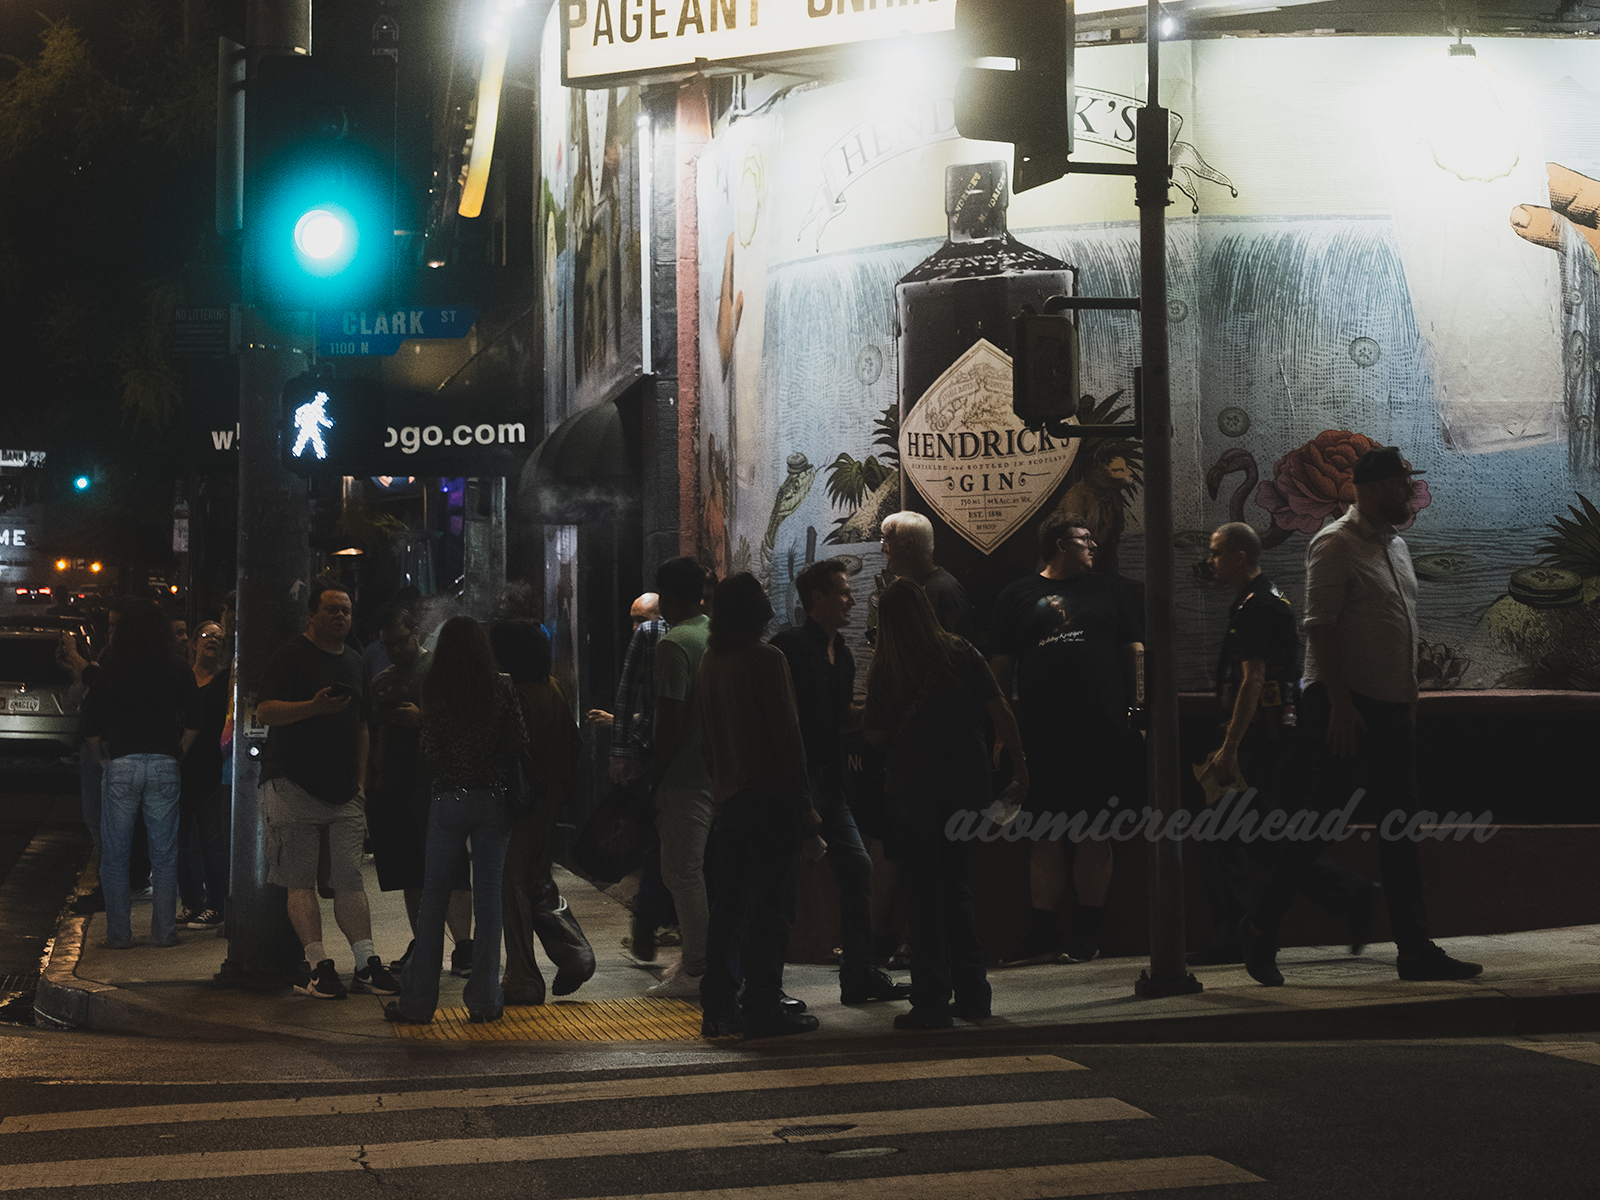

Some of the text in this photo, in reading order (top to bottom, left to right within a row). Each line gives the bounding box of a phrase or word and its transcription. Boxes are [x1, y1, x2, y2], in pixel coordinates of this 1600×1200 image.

[175, 308, 228, 321] NO LITTERING
[342, 310, 457, 335] CLARK ST
[331, 342, 369, 354] 1100 N
[967, 462, 1010, 471] BOTTLED
[1028, 455, 1067, 465] SCOTLAND
[960, 471, 1015, 492] GIN
